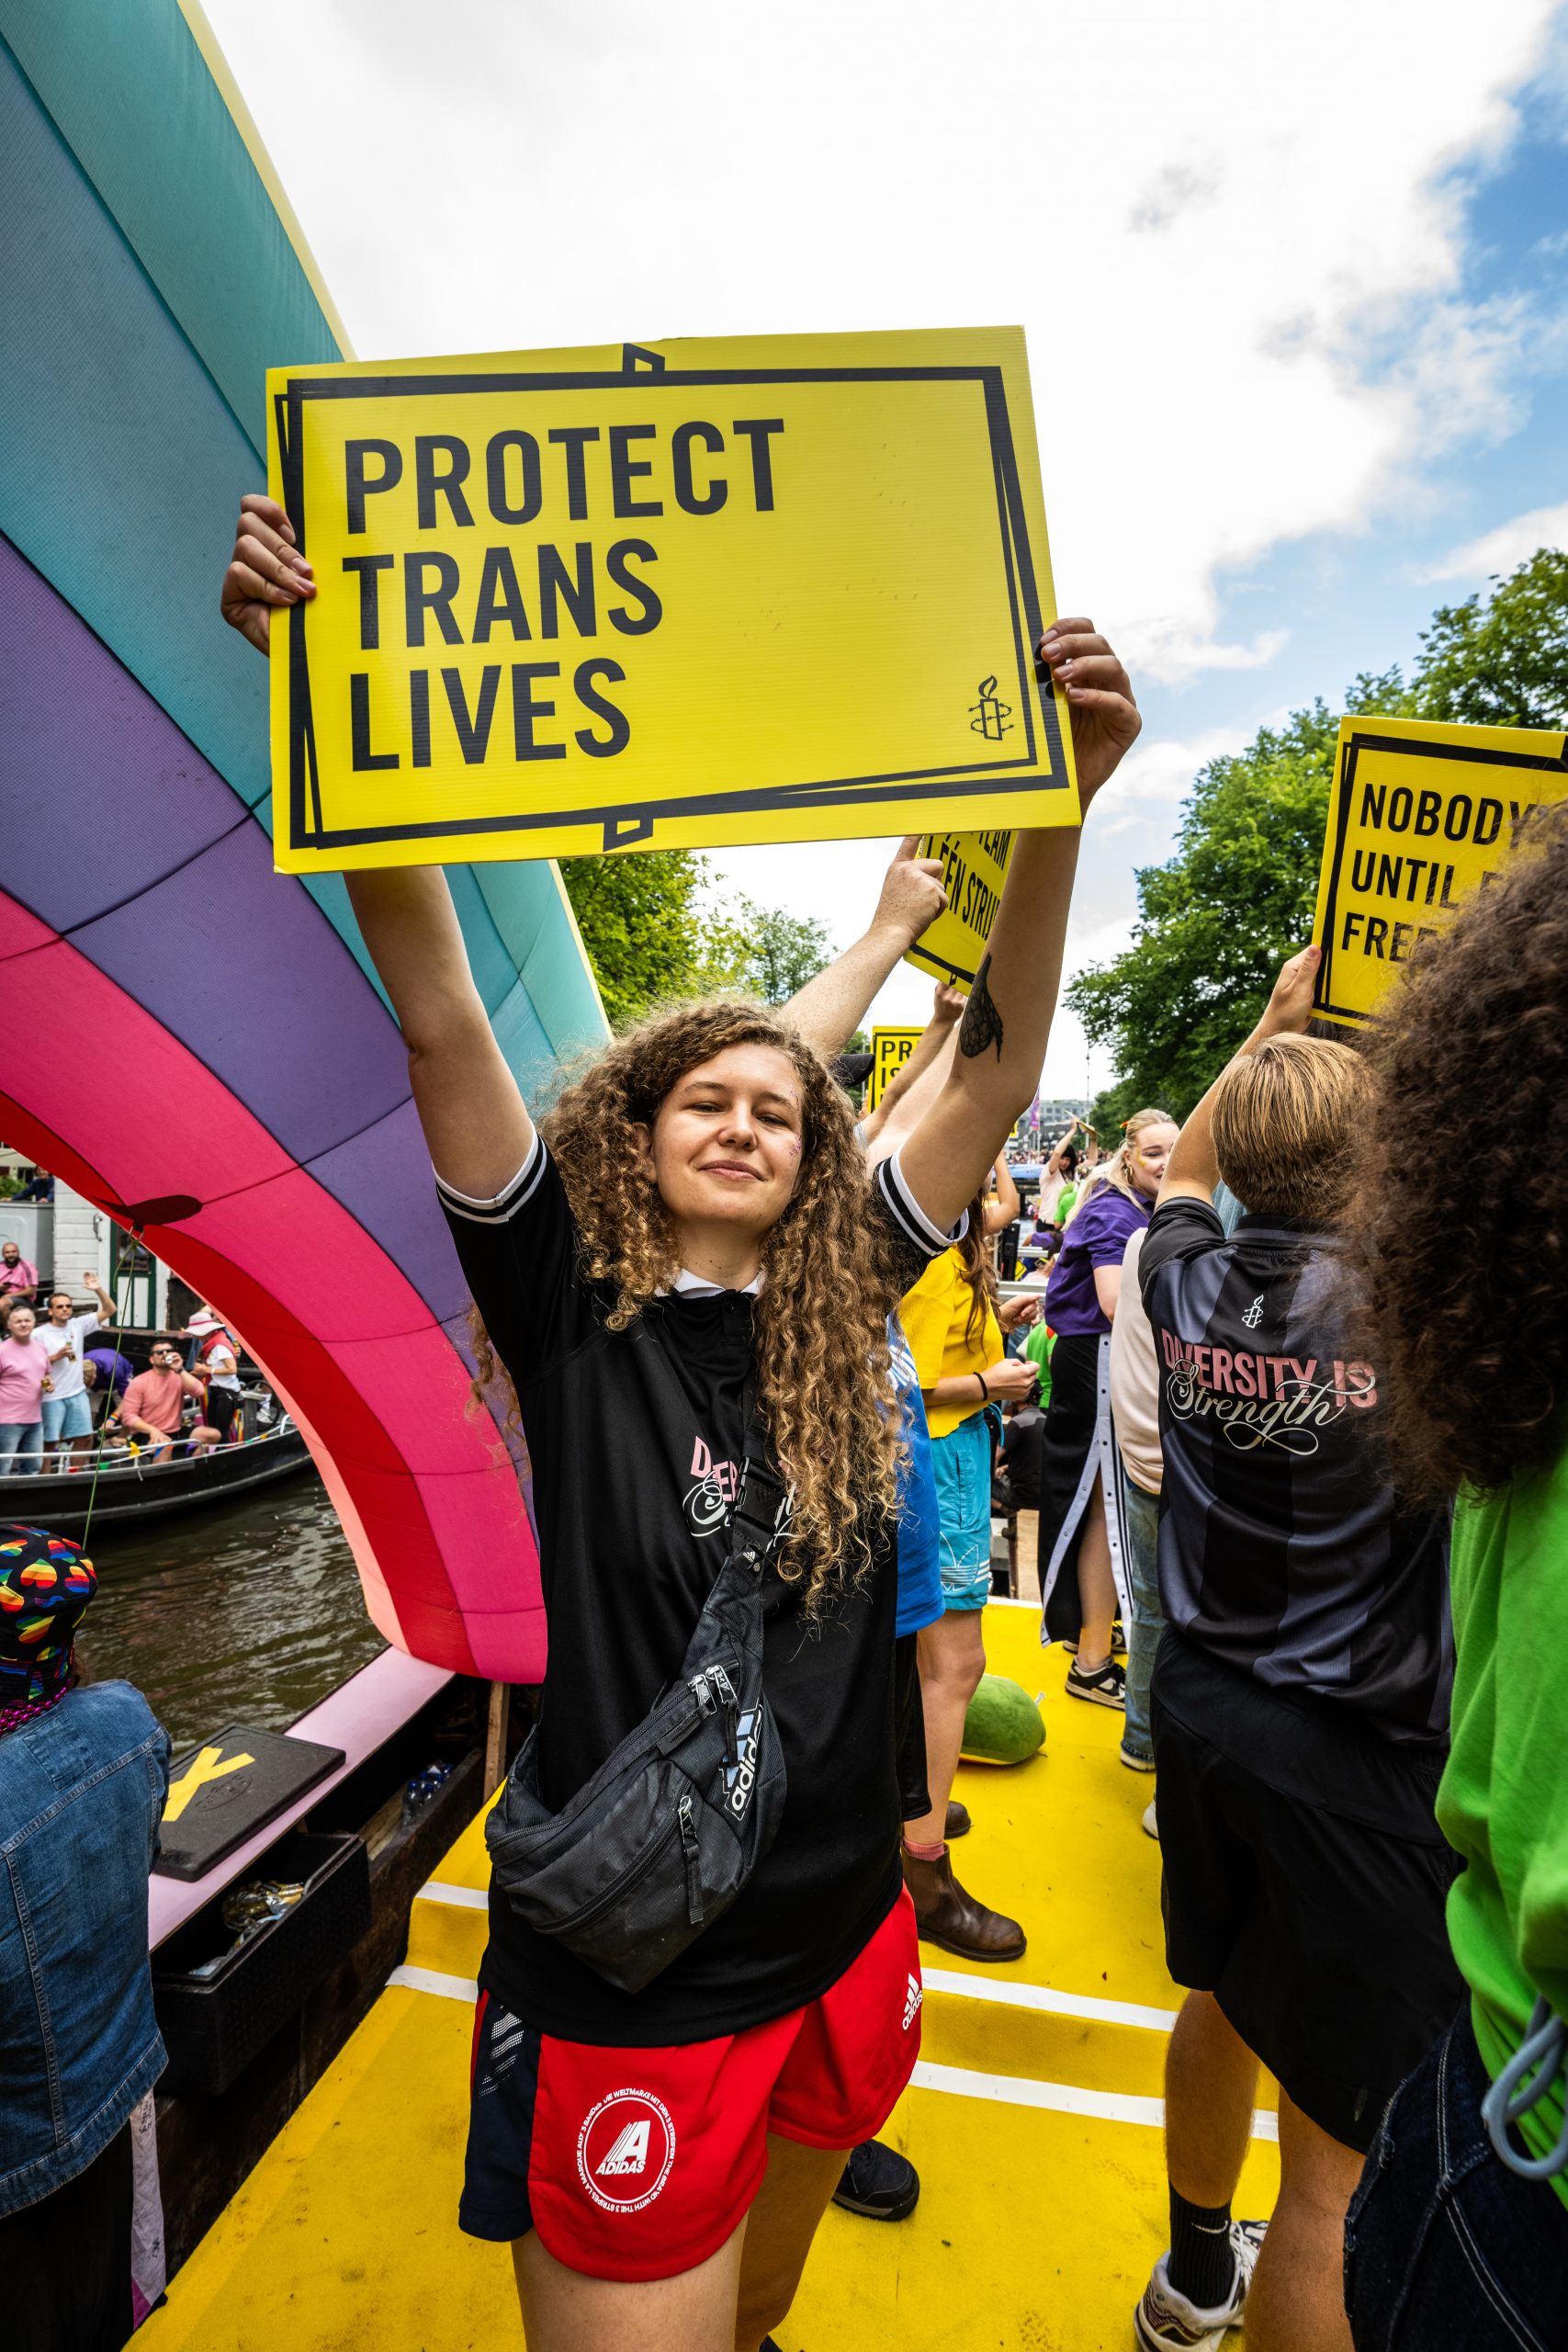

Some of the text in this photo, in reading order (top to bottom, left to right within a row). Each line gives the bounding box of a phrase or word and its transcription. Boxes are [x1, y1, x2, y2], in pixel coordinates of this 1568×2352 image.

[342, 418, 784, 535] PROTECT
[342, 538, 663, 650] TRANS
[350, 658, 631, 773] LIVES
[1351, 849, 1459, 910] UNTIL
[881, 1040, 919, 1062] PR
[1161, 1328, 1378, 1408] DIVERSITY IS
[1167, 1359, 1375, 1455] Strength
[731, 1709, 761, 1811] adid
[613, 2087, 650, 2099] WELTMARKE
[649, 2095, 660, 2106] MIT
[659, 2102, 669, 2119] DEN
[667, 2121, 676, 2160] STREIFEN
[576, 2149, 591, 2185] MARQUE
[584, 2183, 593, 2195] LA
[591, 2160, 673, 2212] THE BRAND WITH THE 3 STRIPES
[595, 2160, 647, 2176] ADIDAS
